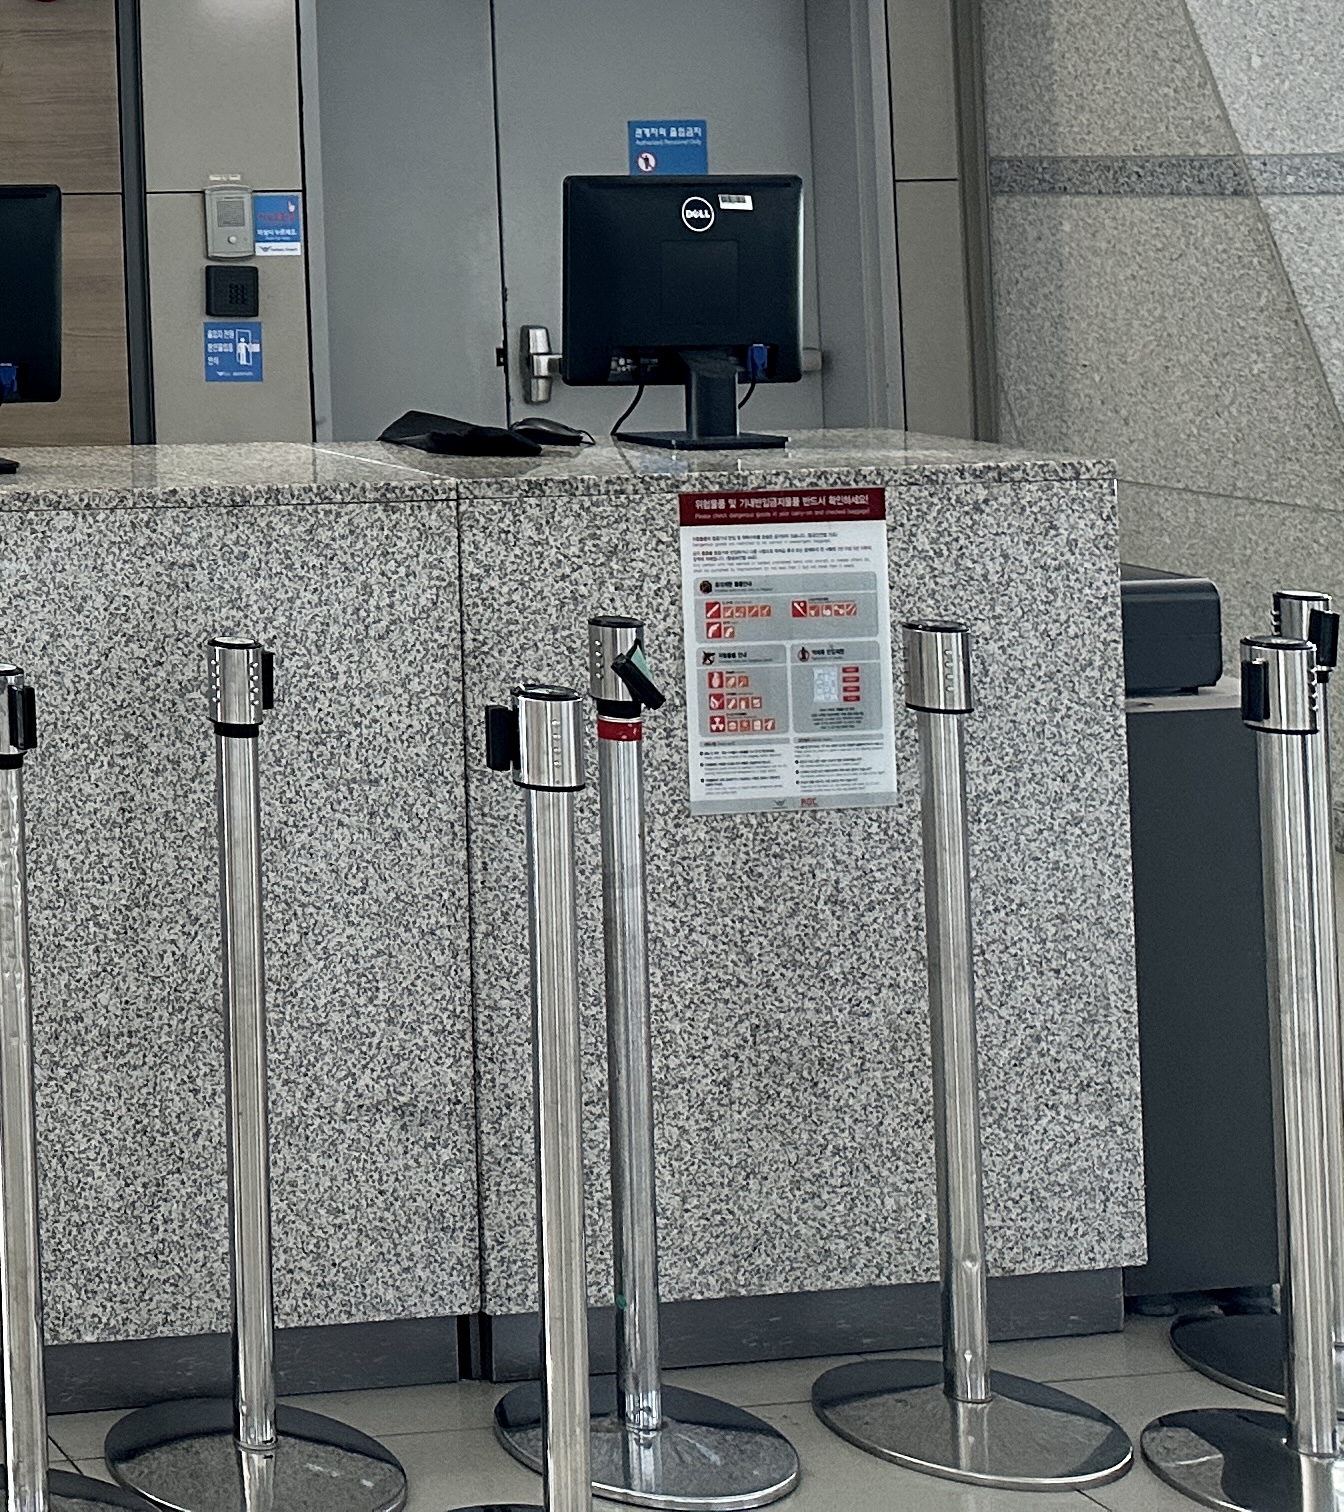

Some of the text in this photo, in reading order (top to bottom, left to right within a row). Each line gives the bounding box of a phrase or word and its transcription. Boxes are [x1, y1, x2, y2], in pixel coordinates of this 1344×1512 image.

[685, 209, 711, 219] DELL
[695, 498, 726, 510] 위험물품
[802, 495, 826, 507] 반드시
